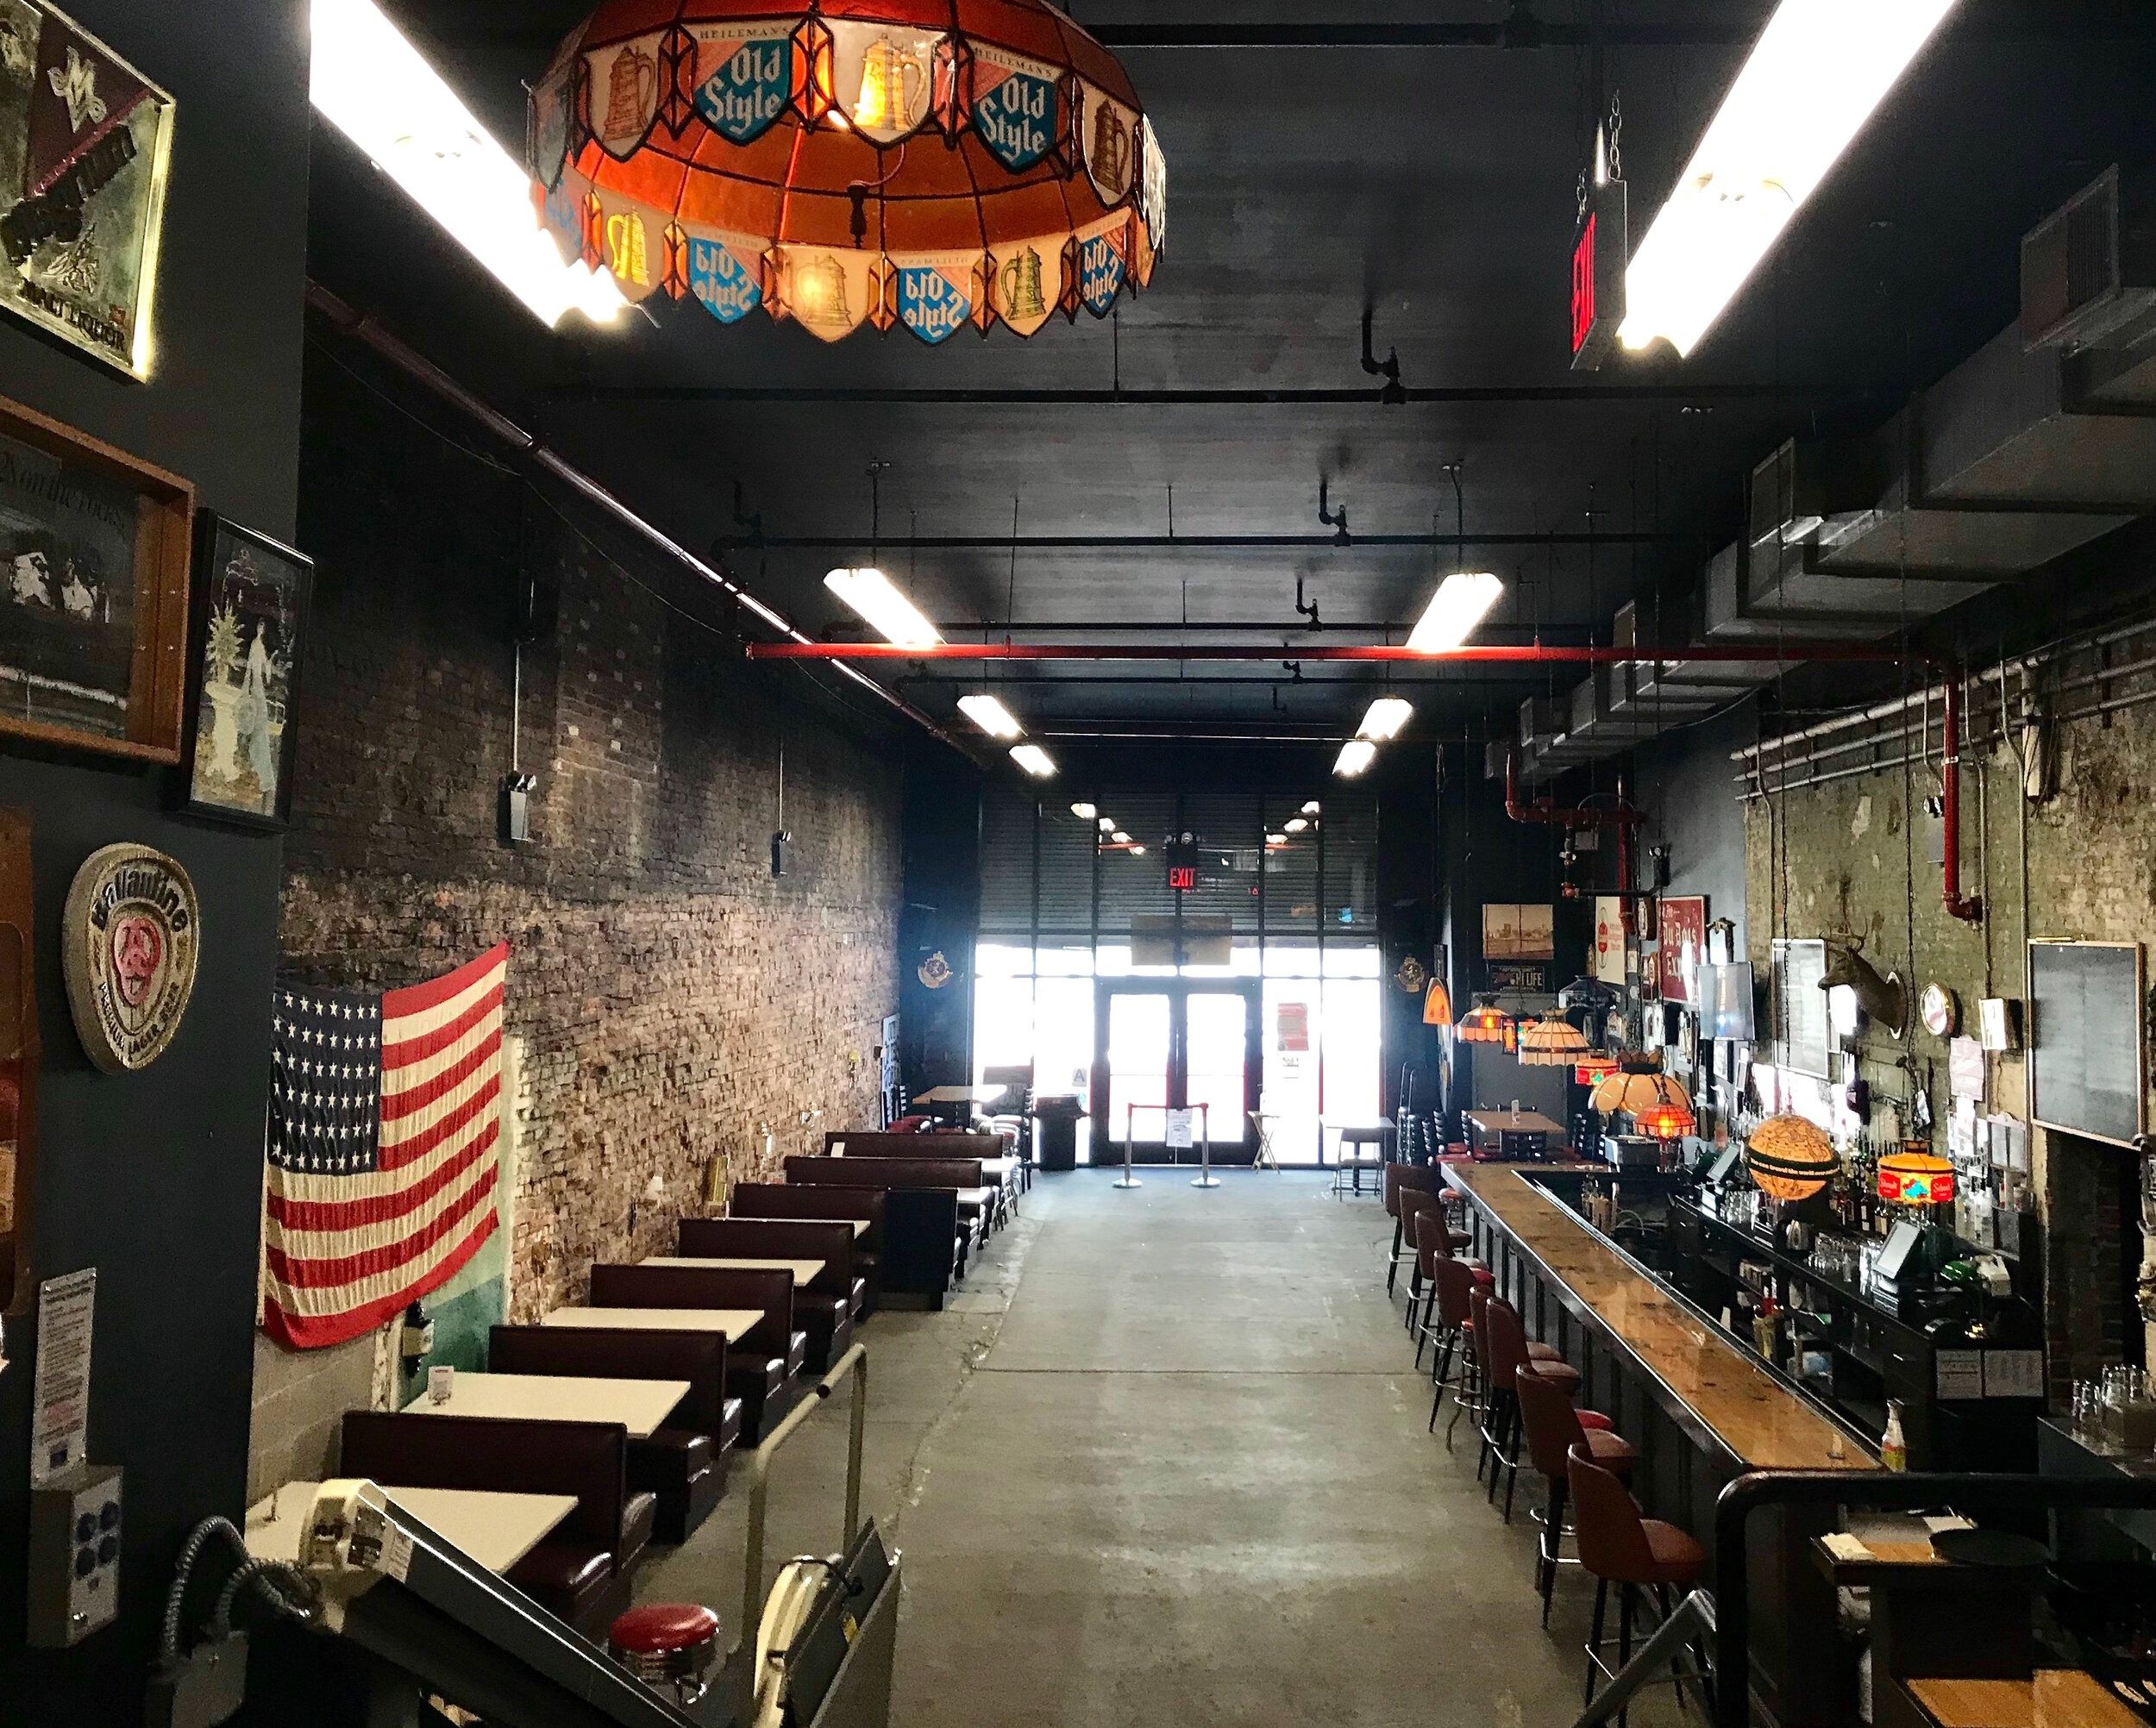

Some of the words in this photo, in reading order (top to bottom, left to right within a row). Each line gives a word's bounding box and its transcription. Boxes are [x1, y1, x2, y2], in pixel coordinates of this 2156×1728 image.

[731, 45, 781, 86] Old
[705, 77, 781, 135] Style
[1002, 77, 1046, 120] Old
[978, 96, 1047, 161] Style
[66, 302, 125, 351] LIQUOR
[1169, 867, 1195, 886] EXIT
[91, 867, 188, 933] Ballantine
[1073, 1068, 1085, 1082] A
